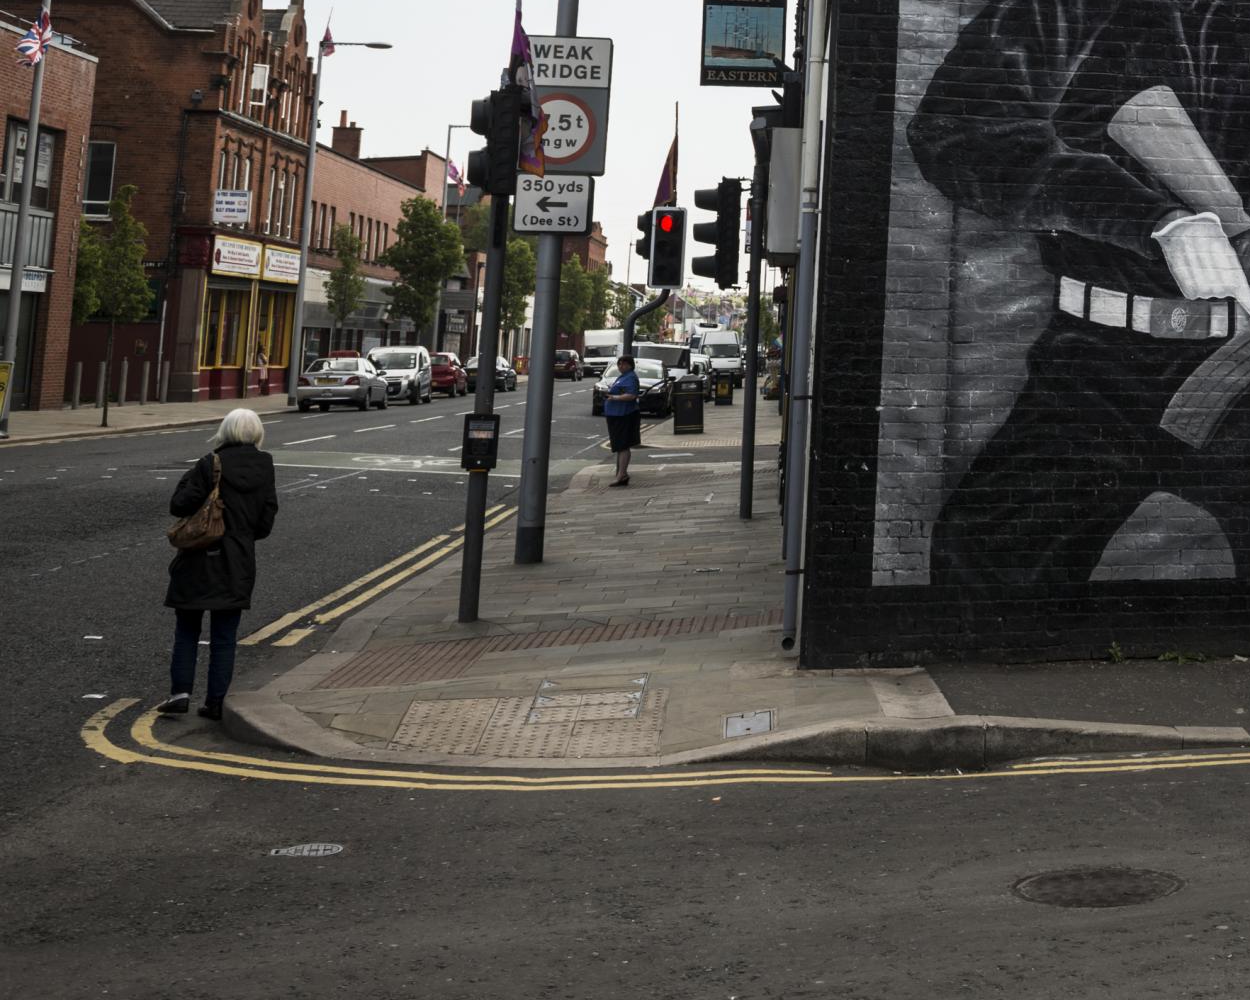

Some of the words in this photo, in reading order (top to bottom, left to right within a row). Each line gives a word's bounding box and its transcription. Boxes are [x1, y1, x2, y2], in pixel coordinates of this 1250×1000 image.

[534, 44, 593, 60] WEAK
[532, 63, 601, 80] RIDGE
[706, 70, 778, 81] EASTERN
[522, 179, 555, 192] 350
[557, 180, 584, 194] yds
[522, 214, 553, 226] (Dee
[557, 215, 579, 227] St)
